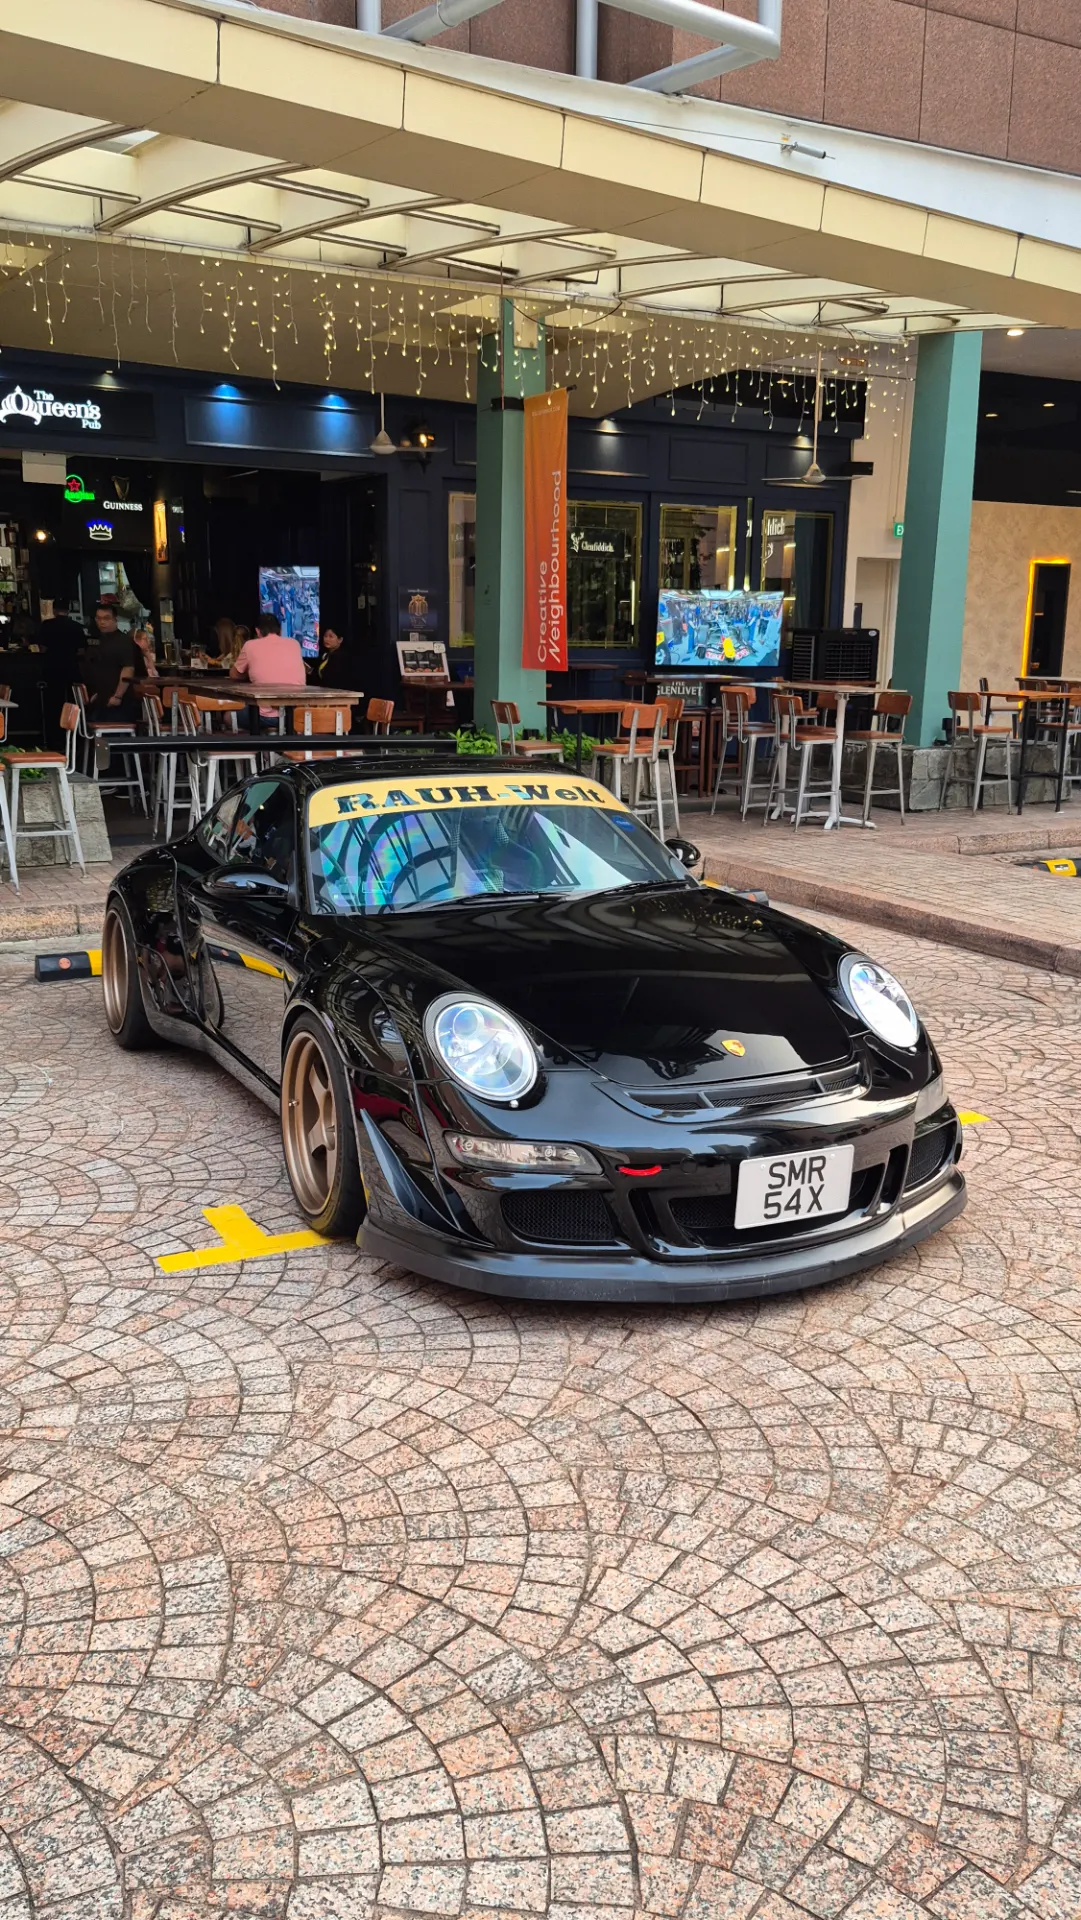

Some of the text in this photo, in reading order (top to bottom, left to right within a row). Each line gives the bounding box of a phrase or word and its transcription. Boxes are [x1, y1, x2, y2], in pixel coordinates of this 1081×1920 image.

[33, 389, 54, 401] The
[82, 419, 102, 430] Pub
[103, 501, 143, 512] GUINNESS
[549, 470, 563, 664] Neighbourhood
[537, 561, 548, 663] Creative
[334, 785, 605, 814] RAUH-Welt
[767, 1155, 827, 1190] SMR
